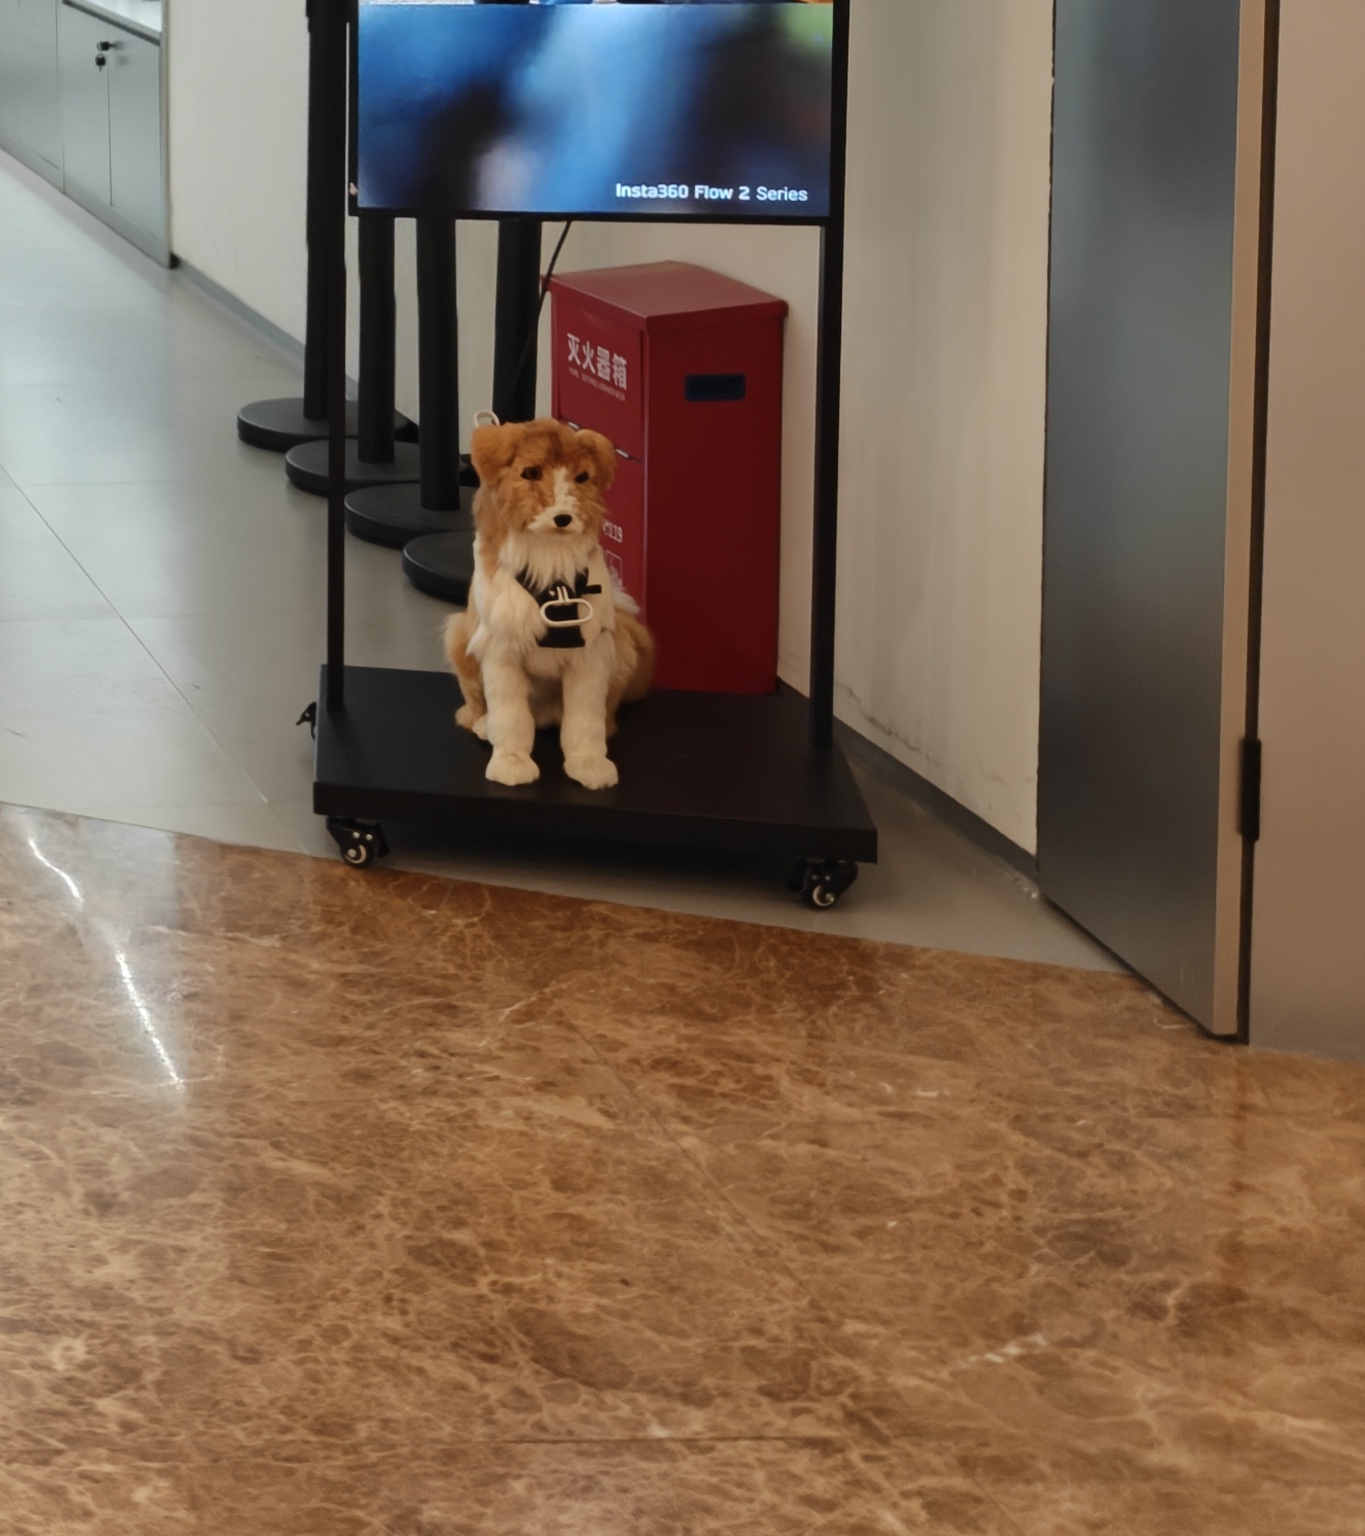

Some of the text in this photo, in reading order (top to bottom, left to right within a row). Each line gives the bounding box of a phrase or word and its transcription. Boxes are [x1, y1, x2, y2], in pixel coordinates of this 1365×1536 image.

[615, 183, 808, 202] Insta360 Flow 2 Series
[567, 333, 627, 390] 灭火器箱
